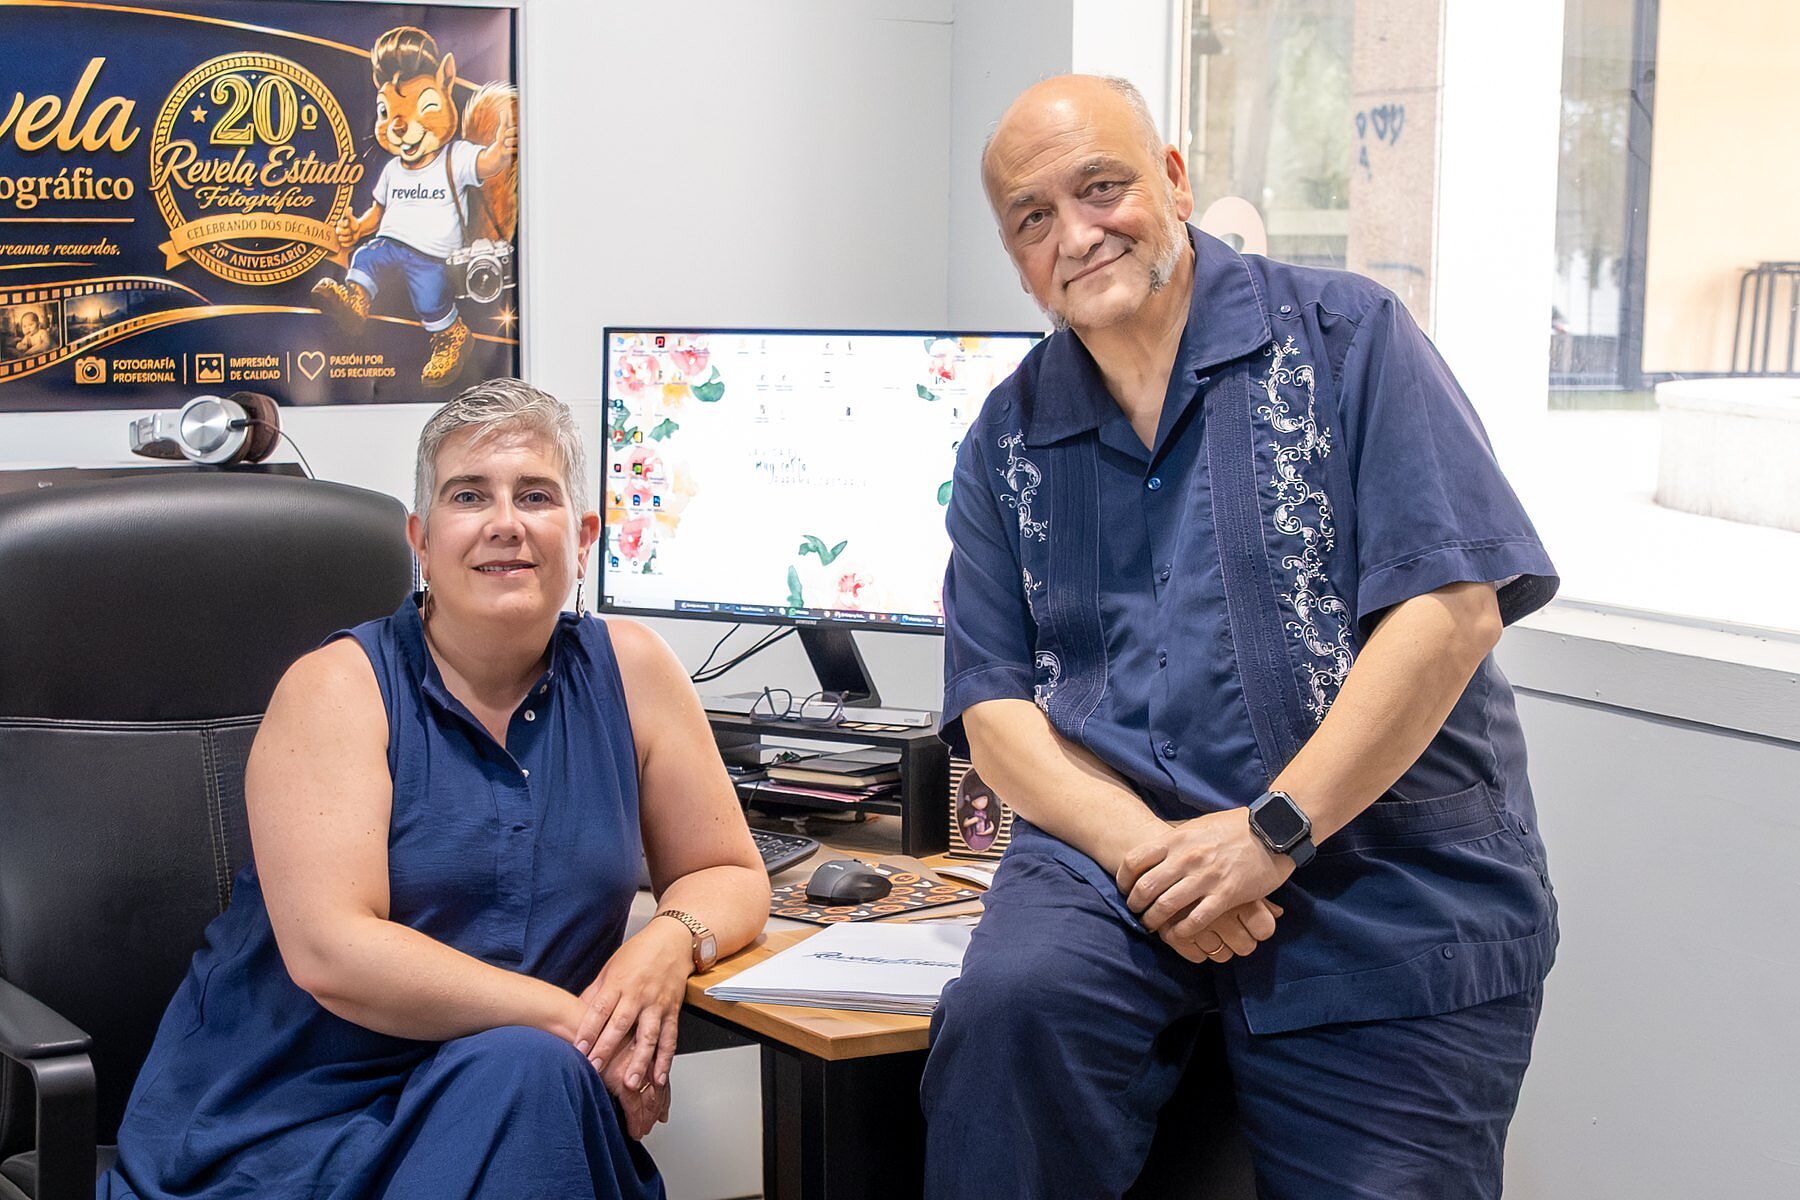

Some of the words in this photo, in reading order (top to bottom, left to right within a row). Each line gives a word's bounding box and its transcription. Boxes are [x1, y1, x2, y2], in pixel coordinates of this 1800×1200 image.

[149, 138, 258, 191] Revela
[259, 145, 365, 188] Estudio
[0, 167, 134, 210] ográfico
[392, 183, 446, 199] revela.es
[194, 185, 316, 213] Fotográfico
[186, 219, 257, 241] CELEBRANDO
[260, 219, 282, 232] DOS
[284, 222, 332, 242] DÉCADAS
[53, 237, 121, 256] recuerdos.
[229, 244, 308, 269] ANIVERSARIO
[112, 356, 176, 370] FOTOGRAFÍA
[230, 355, 279, 368] IMPRESIÓN
[329, 354, 363, 366] PASIÓN
[364, 354, 384, 365] POR
[112, 372, 176, 383] PROFESIONAL
[230, 370, 242, 380] DE
[243, 369, 281, 380] CALIDAD
[329, 368, 346, 378] LOS
[347, 367, 396, 378] RECUERDOS
